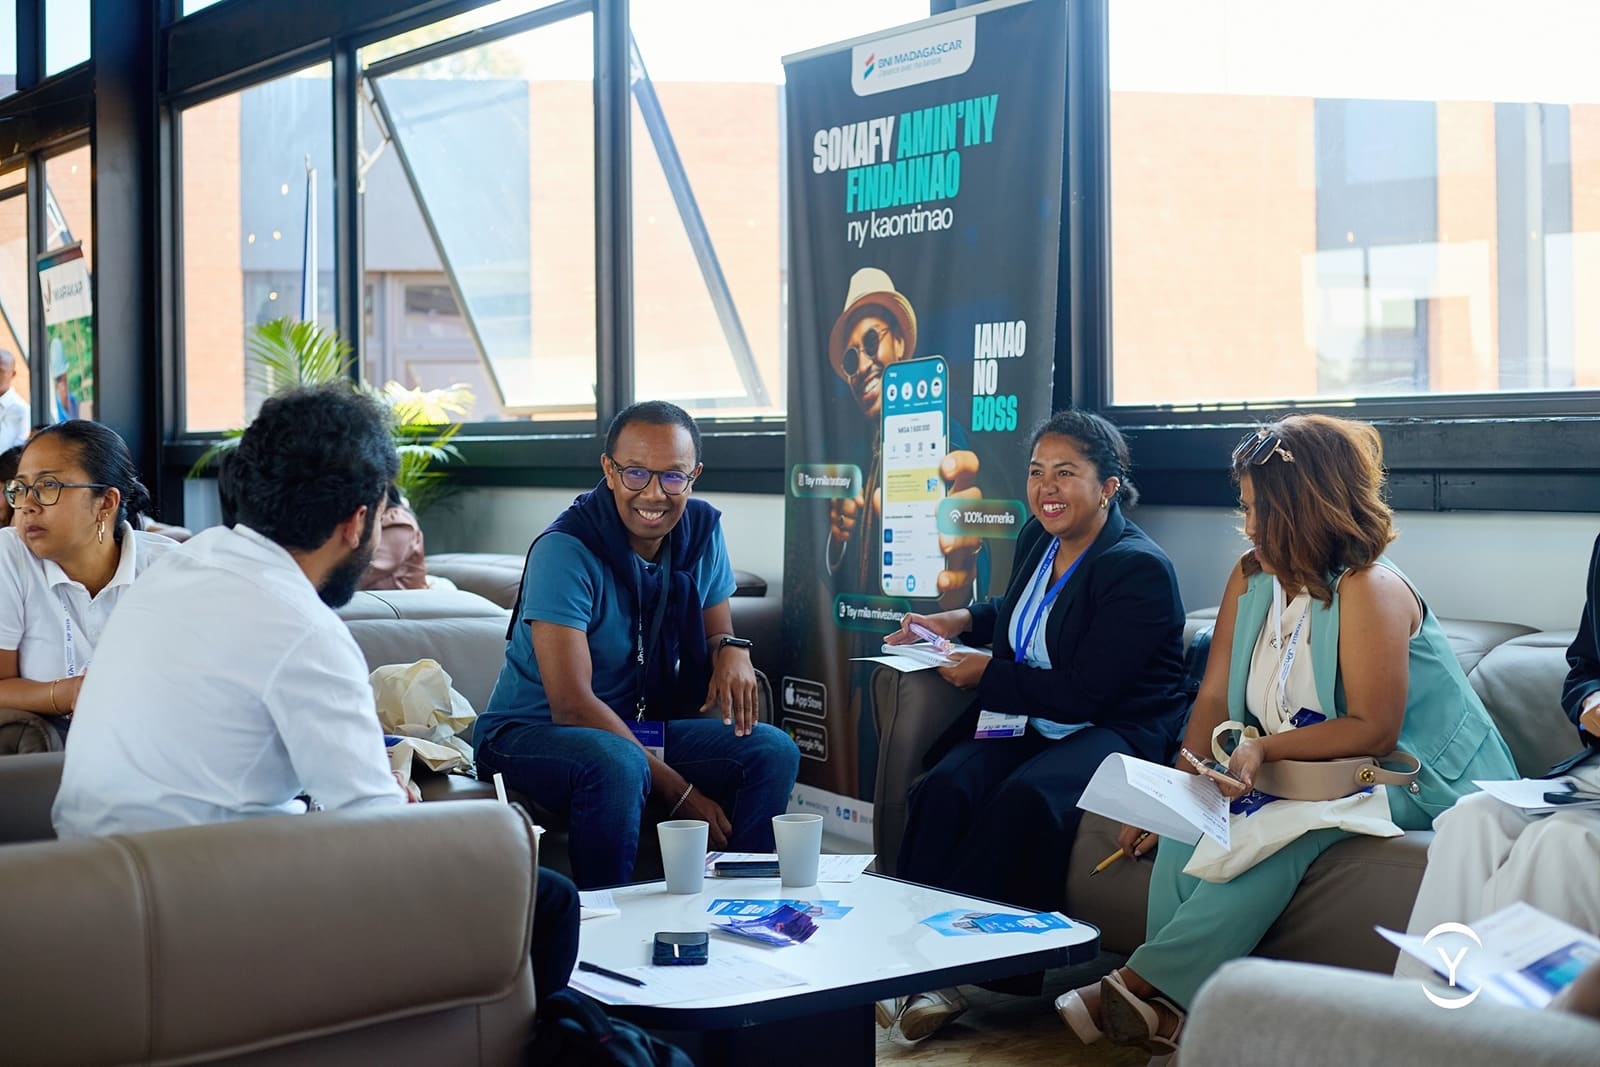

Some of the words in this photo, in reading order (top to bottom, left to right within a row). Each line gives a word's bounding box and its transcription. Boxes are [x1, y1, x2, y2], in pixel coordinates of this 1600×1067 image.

[878, 56, 893, 69] BNI
[894, 39, 963, 63] MADAGASCAR
[813, 115, 895, 174] SOKAFY
[846, 151, 960, 213] FINDAINAO
[847, 220, 870, 248] ny
[870, 204, 953, 239] kaontinao
[974, 320, 1026, 359] IANAO
[973, 359, 998, 395] NO
[972, 395, 1018, 431] BOSS
[964, 511, 982, 524] 100%
[983, 512, 1015, 524] nomerika
[795, 694, 807, 708] App
[807, 696, 822, 710] Store
[814, 740, 825, 754] Play
